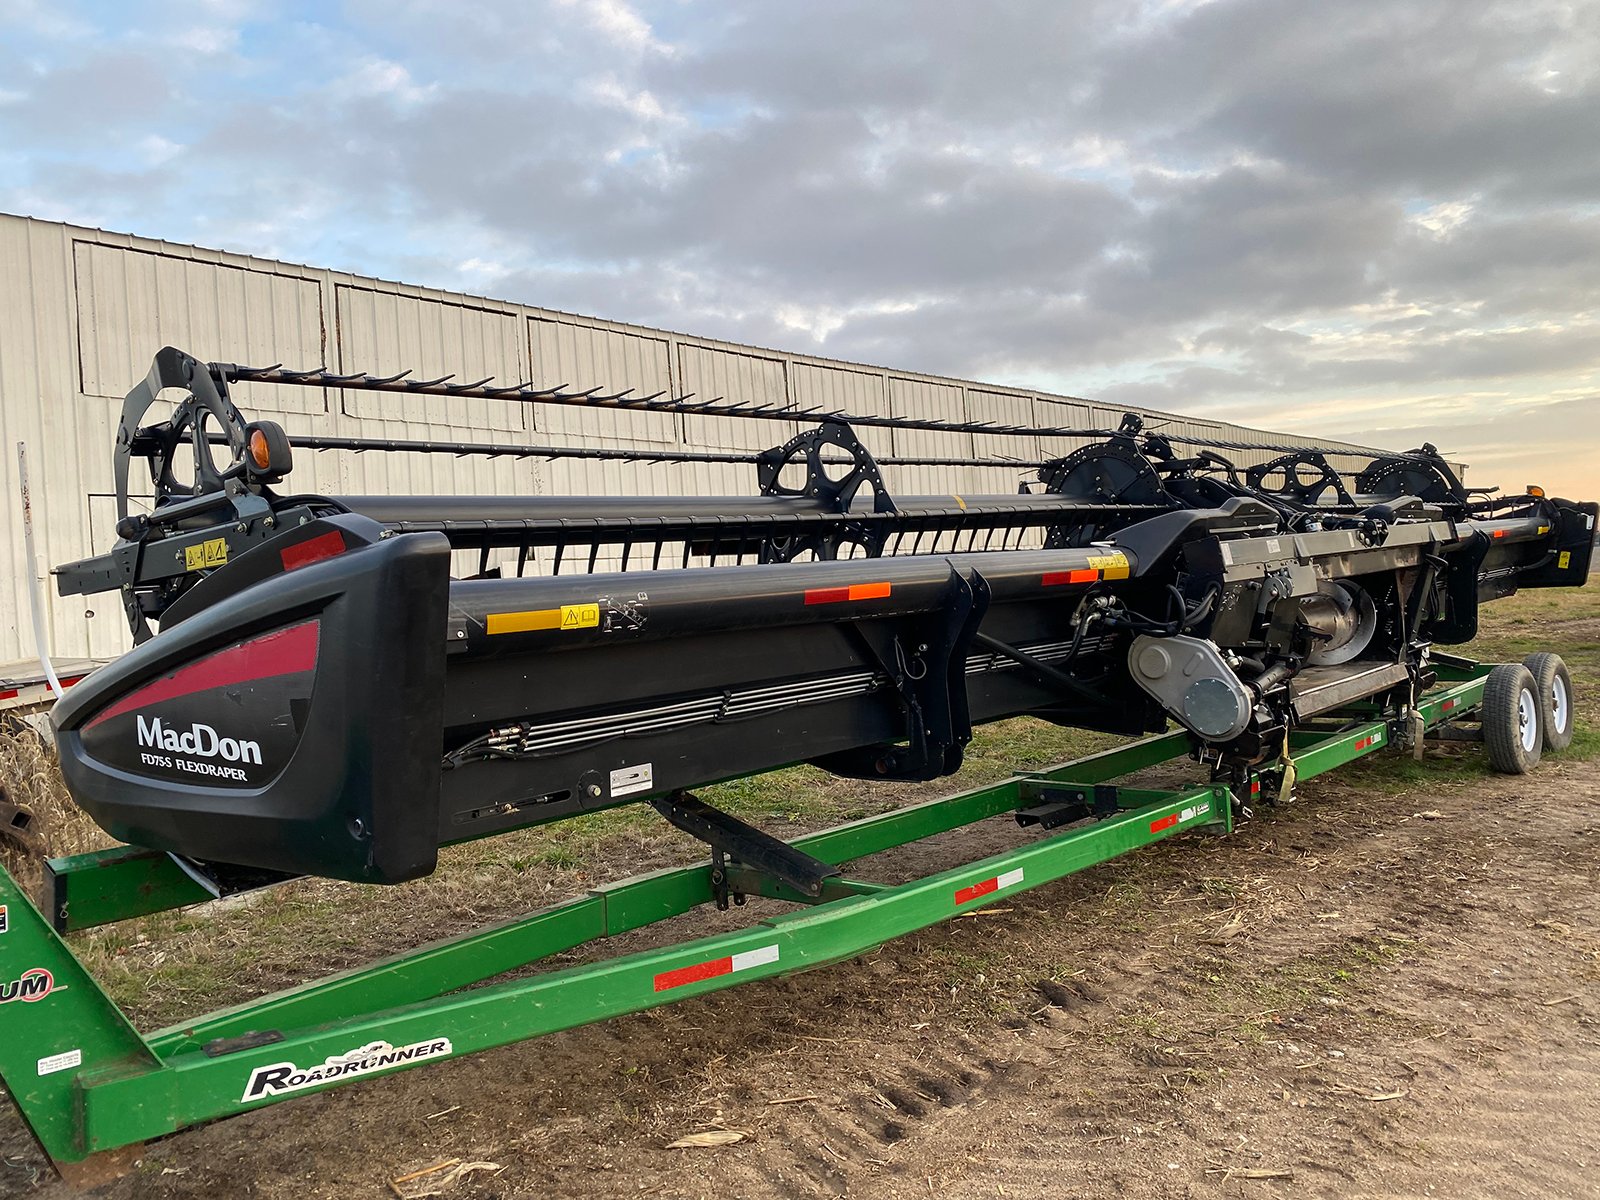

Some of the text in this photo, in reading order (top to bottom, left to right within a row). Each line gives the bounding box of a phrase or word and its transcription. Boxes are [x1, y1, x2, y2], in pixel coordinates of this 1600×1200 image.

[136, 714, 263, 765] MacDon
[140, 752, 248, 782] FD75-S FLEXDRAPER
